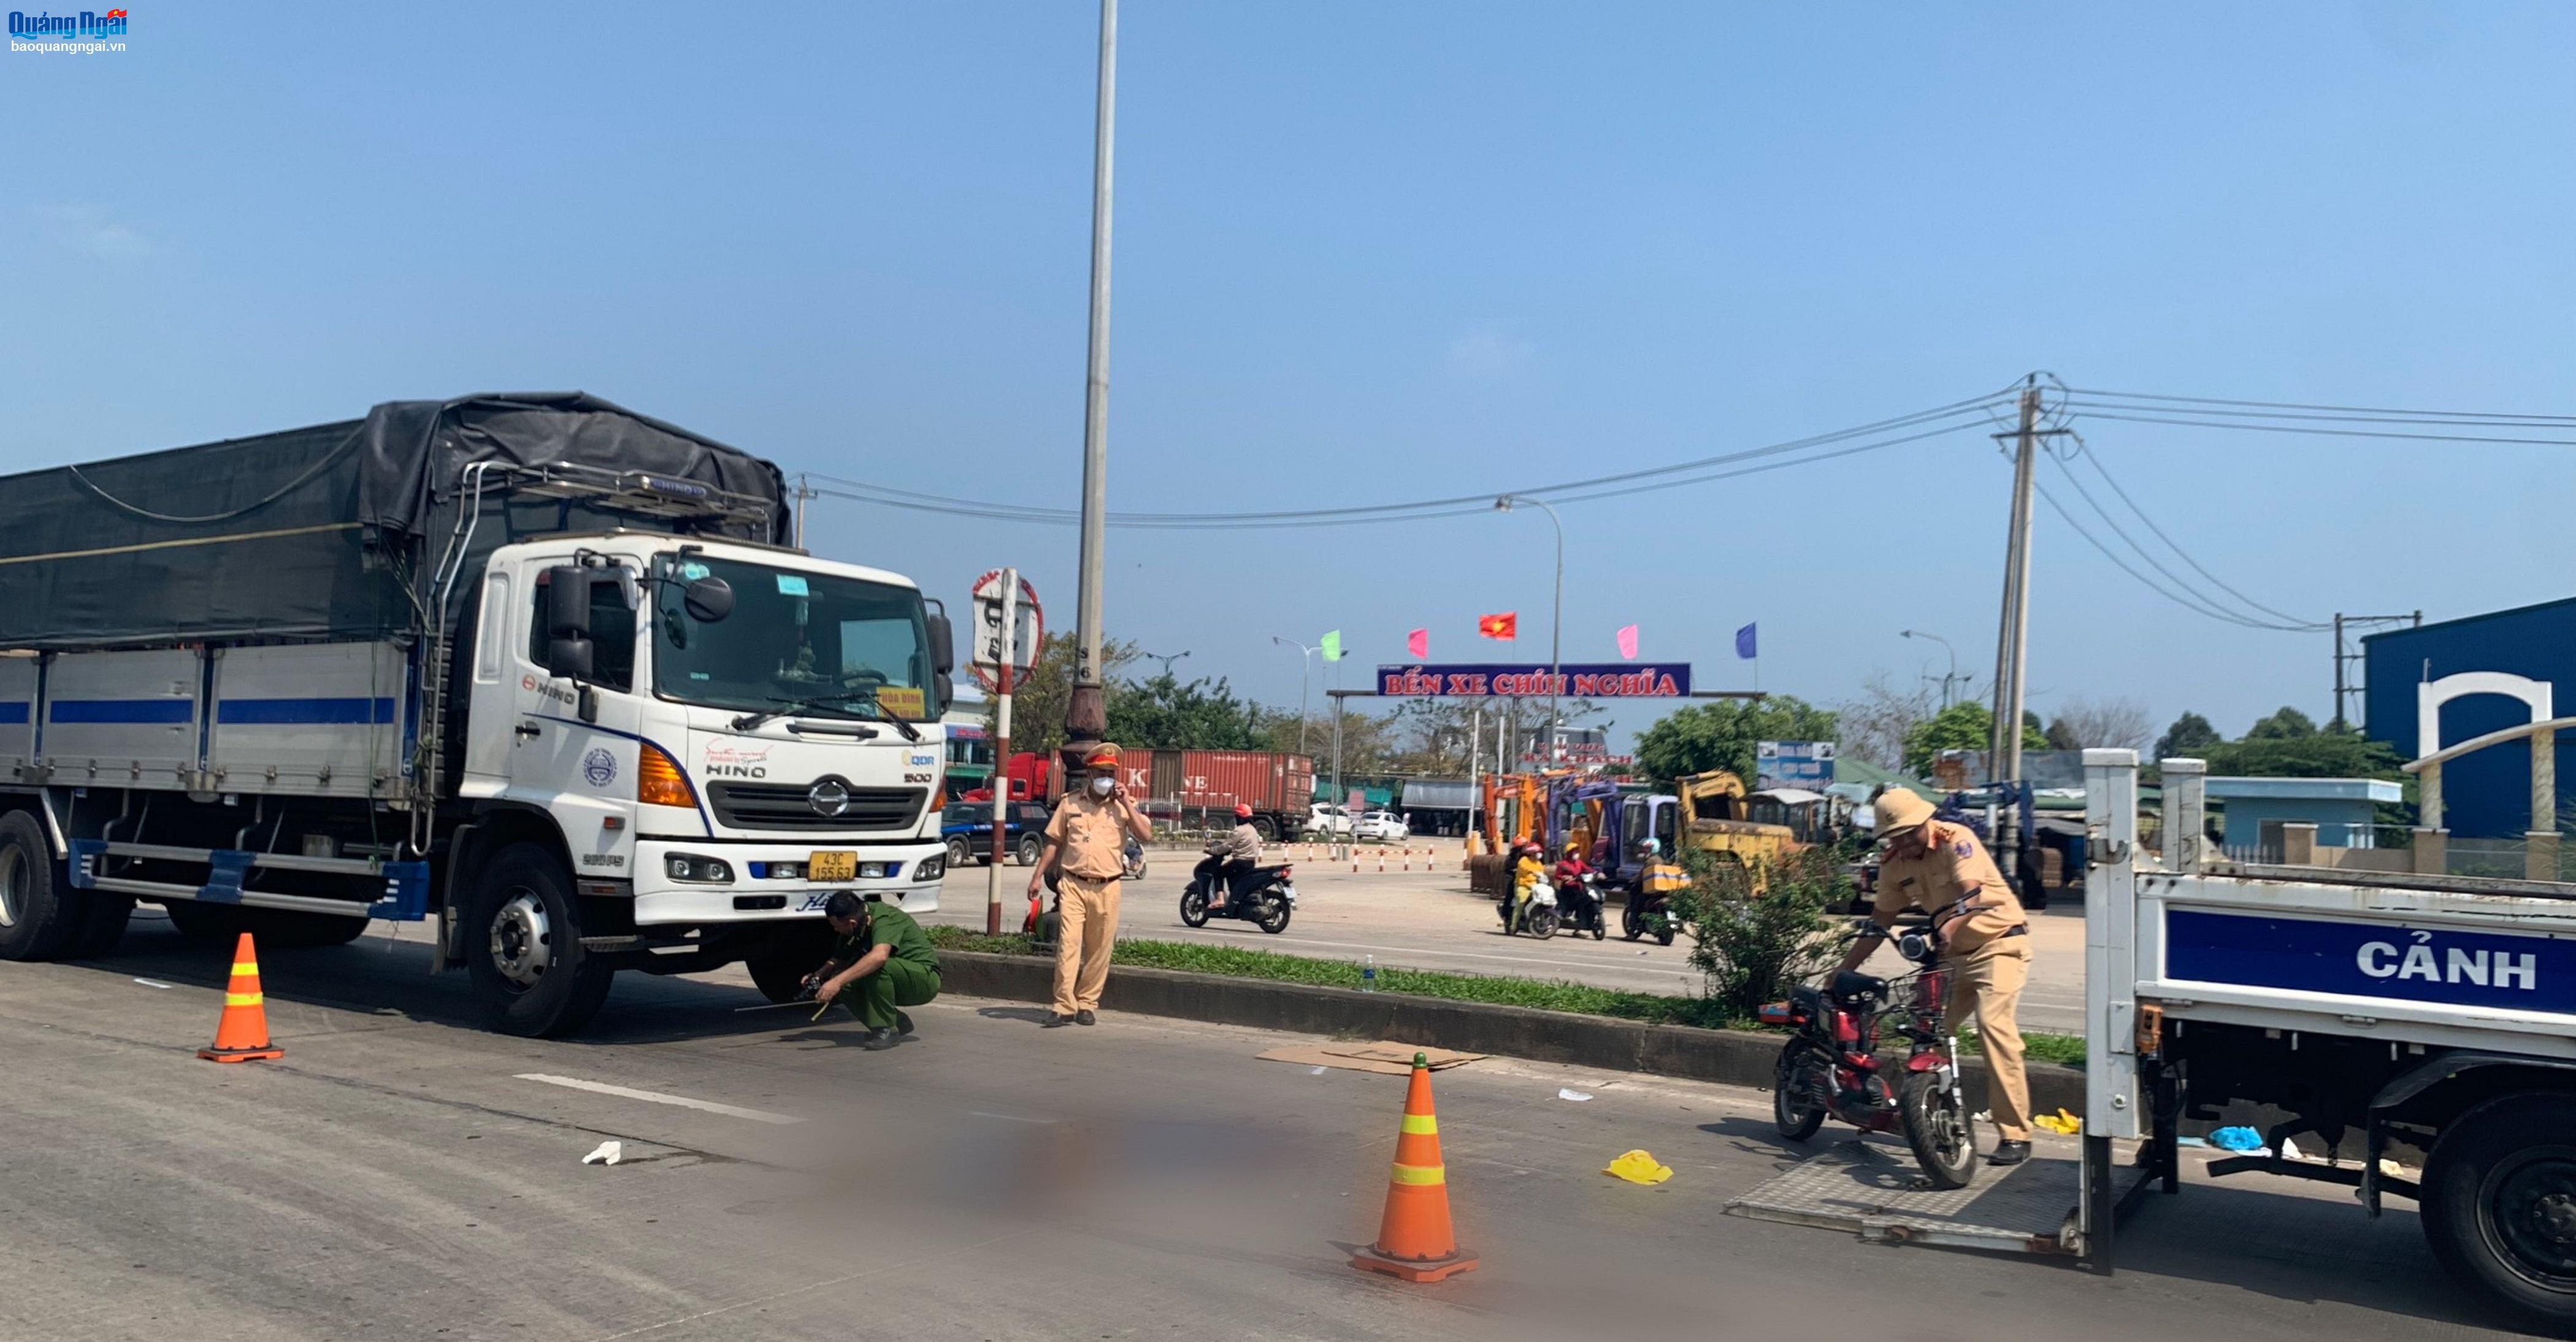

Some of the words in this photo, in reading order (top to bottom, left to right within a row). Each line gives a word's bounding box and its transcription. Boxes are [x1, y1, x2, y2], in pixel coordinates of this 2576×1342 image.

[1385, 665, 1443, 695] BẾN
[1447, 674, 1487, 695] XE
[1492, 668, 1568, 696] CHÍN
[1573, 668, 1679, 696] NGHĨA
[537, 681, 575, 705] HINO
[911, 756, 934, 766] QDR
[706, 764, 766, 778] HINO
[904, 773, 932, 783] 500
[823, 853, 844, 865] 43C
[2356, 930, 2536, 990] CẢNH
